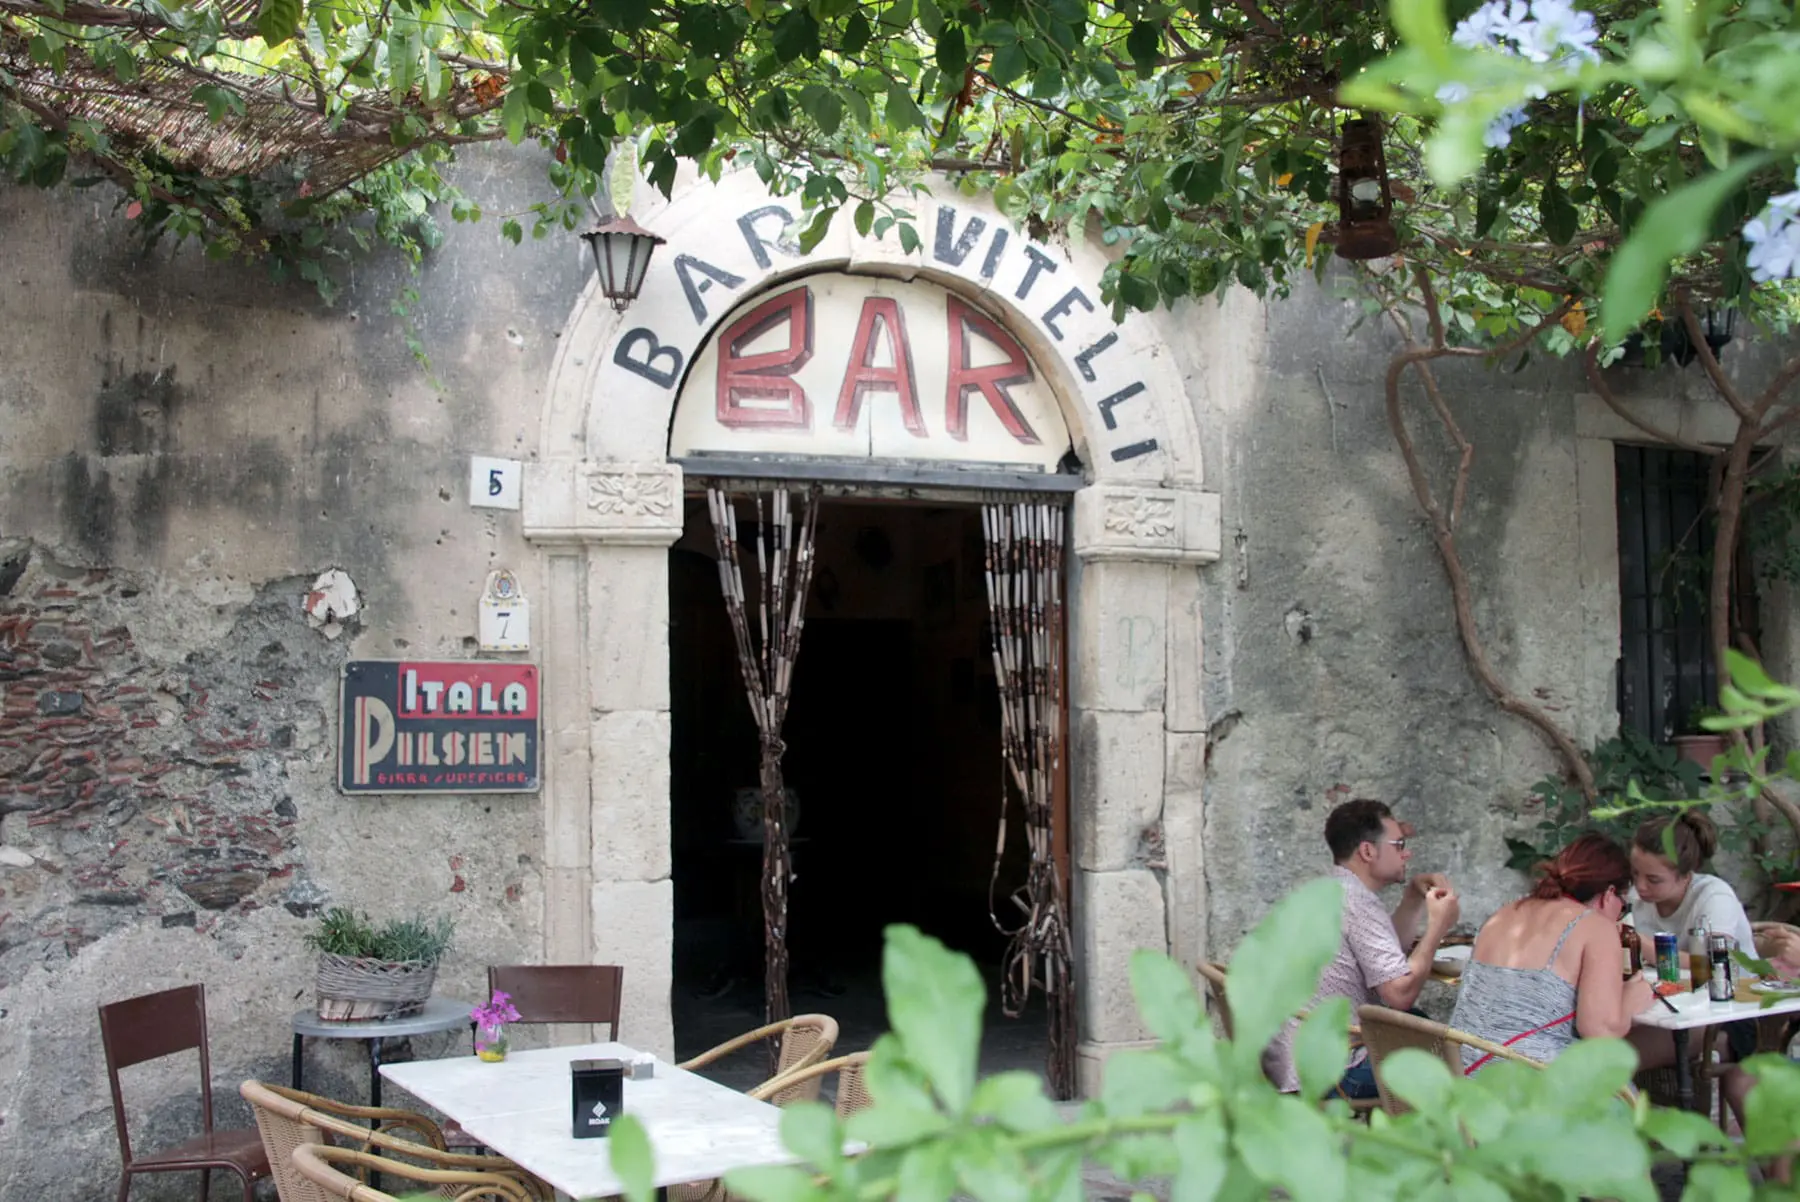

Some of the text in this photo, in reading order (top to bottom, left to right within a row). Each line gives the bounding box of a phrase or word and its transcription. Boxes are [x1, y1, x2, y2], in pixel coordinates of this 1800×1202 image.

[613, 204, 1158, 462] BAR VITELLI
[715, 285, 1041, 445] BAR
[489, 469, 503, 496] 5
[496, 611, 511, 639] 7
[402, 669, 528, 714] ITALA
[353, 696, 526, 785] PILSEN
[377, 772, 429, 785] BIRRA
